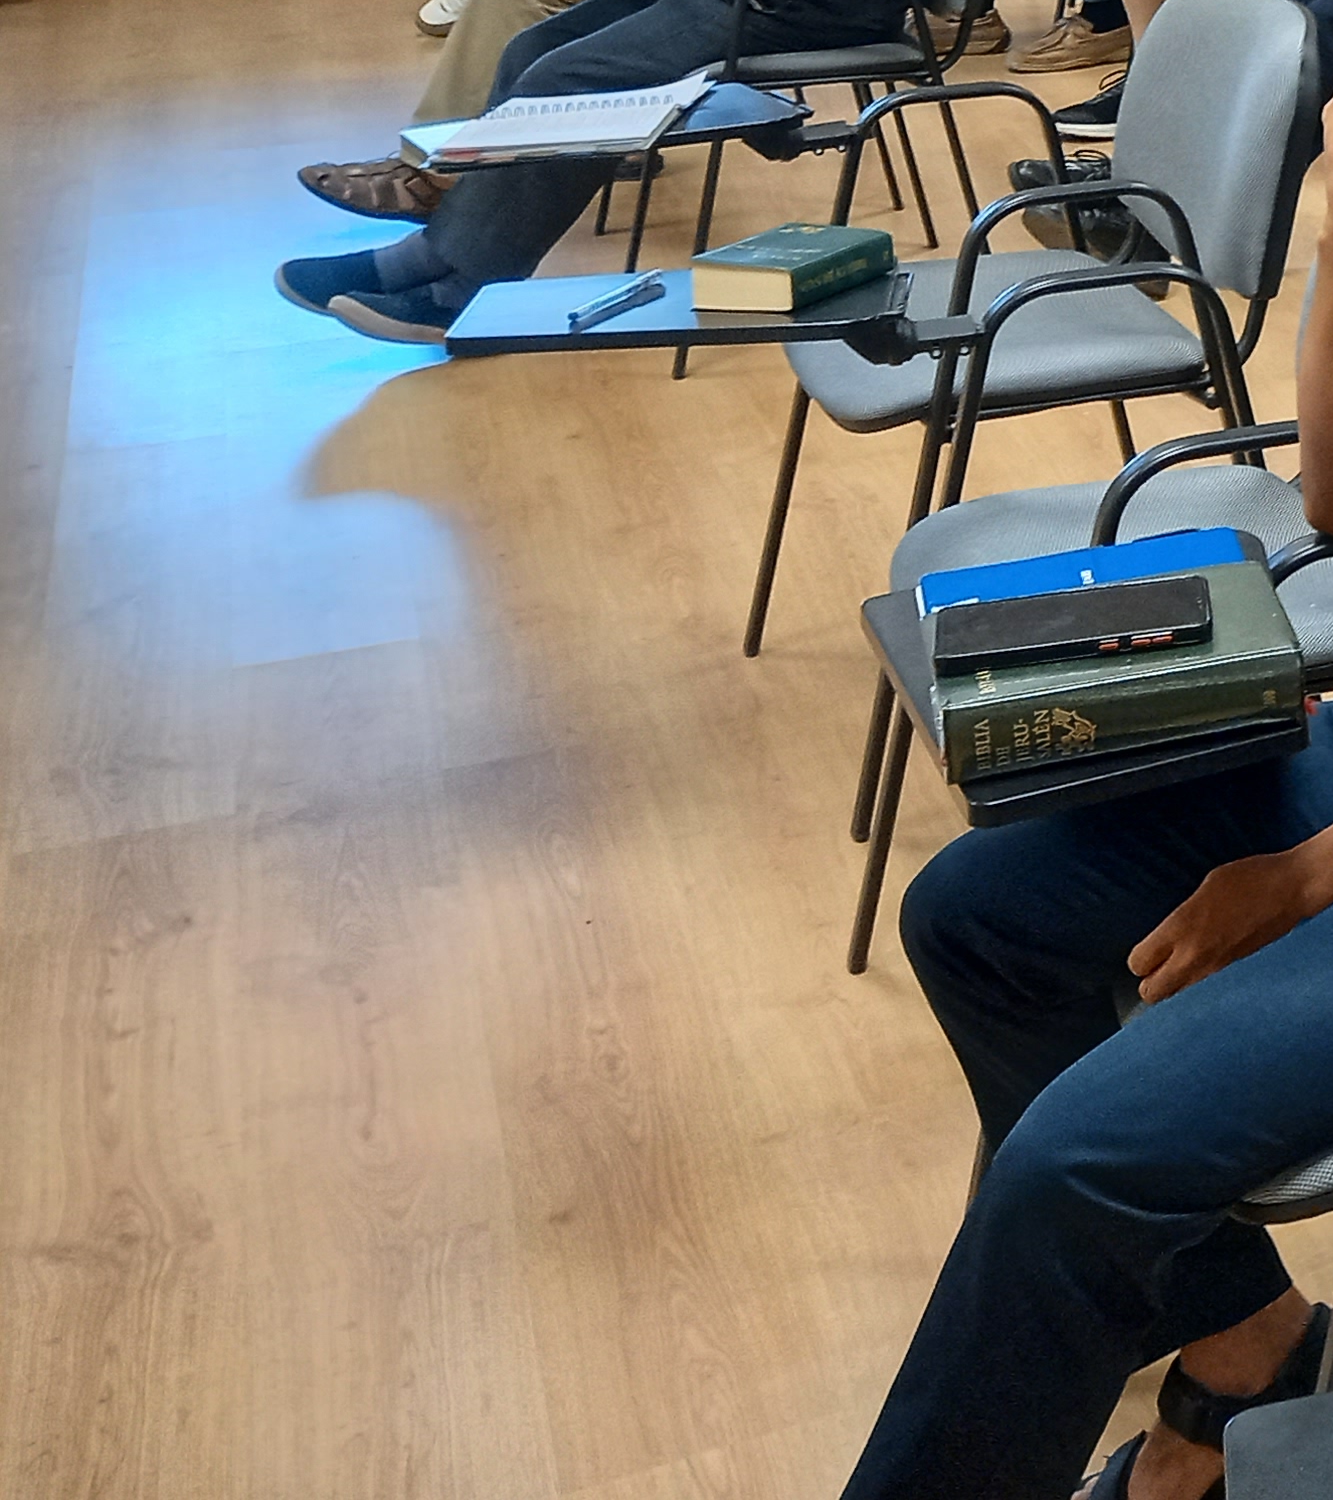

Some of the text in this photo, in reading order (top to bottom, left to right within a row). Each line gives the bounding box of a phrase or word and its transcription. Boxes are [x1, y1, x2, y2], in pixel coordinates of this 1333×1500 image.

[974, 718, 991, 770] BIBLIA
[996, 746, 1010, 767] DE
[1032, 709, 1051, 759] SALÉN
